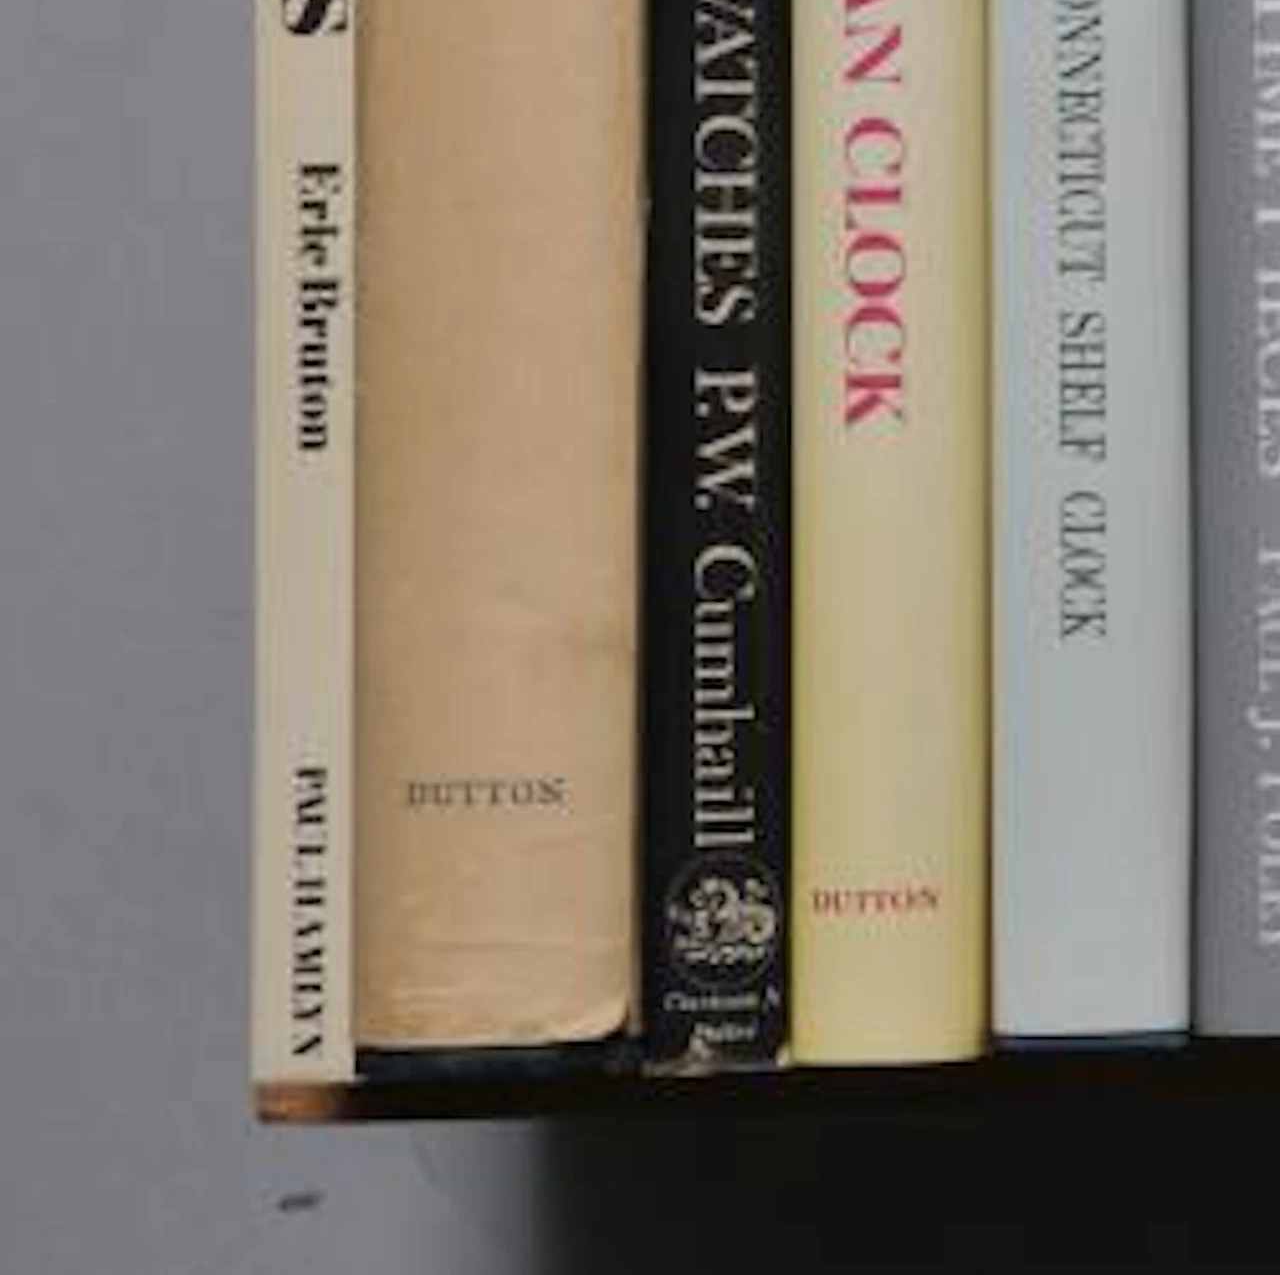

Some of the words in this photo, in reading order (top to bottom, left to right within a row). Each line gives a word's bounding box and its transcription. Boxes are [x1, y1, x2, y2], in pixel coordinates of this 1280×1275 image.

[300, 162, 341, 267] Eric
[843, 116, 907, 430] CLOCK
[300, 278, 339, 452] Bruton
[1058, 311, 1107, 463] SHELF
[1058, 490, 1107, 641] CLOCK
[692, 544, 757, 847] Cumhaill
[407, 777, 567, 808] DUTTON
[812, 885, 941, 915] DUTTON
